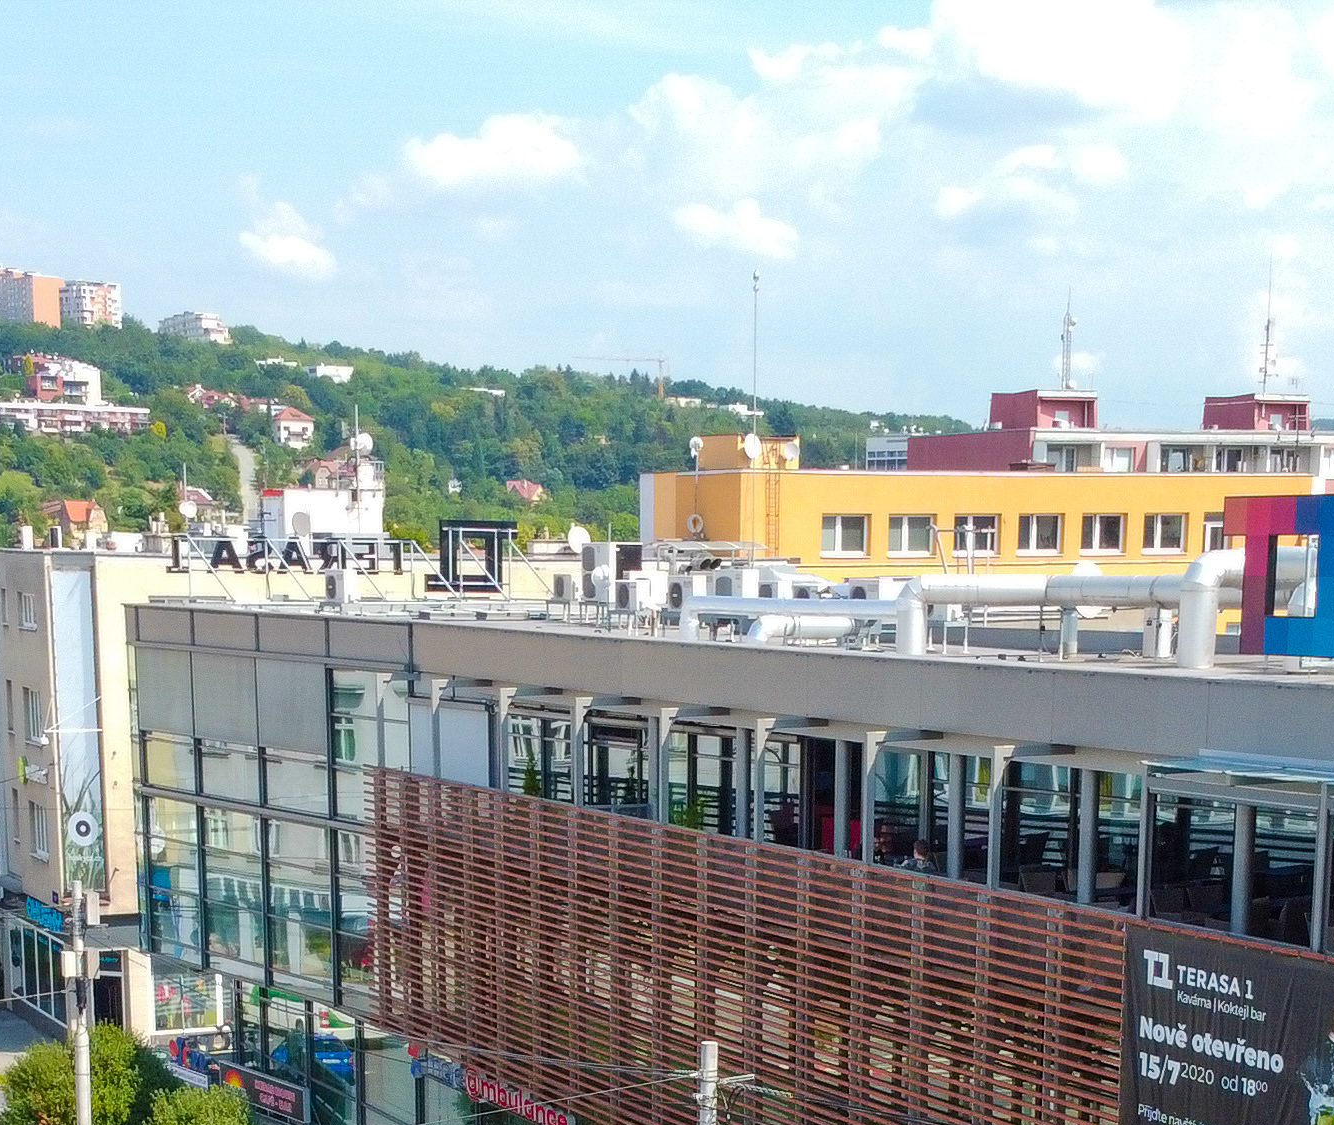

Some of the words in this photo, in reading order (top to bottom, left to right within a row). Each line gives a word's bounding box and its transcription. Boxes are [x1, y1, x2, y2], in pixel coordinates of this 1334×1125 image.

[1177, 964, 1241, 999] TERASA
[1244, 979, 1254, 1000] 1
[1177, 989, 1212, 1009] Kavárna
[1217, 999, 1249, 1020] Koktejl
[1250, 1005, 1267, 1022] bar
[1139, 1015, 1187, 1048] Nově
[1191, 1034, 1284, 1074] otevřeno
[1181, 1062, 1215, 1085] 2020
[1221, 1075, 1239, 1092] od
[1137, 1103, 1167, 1125] Přijďte
